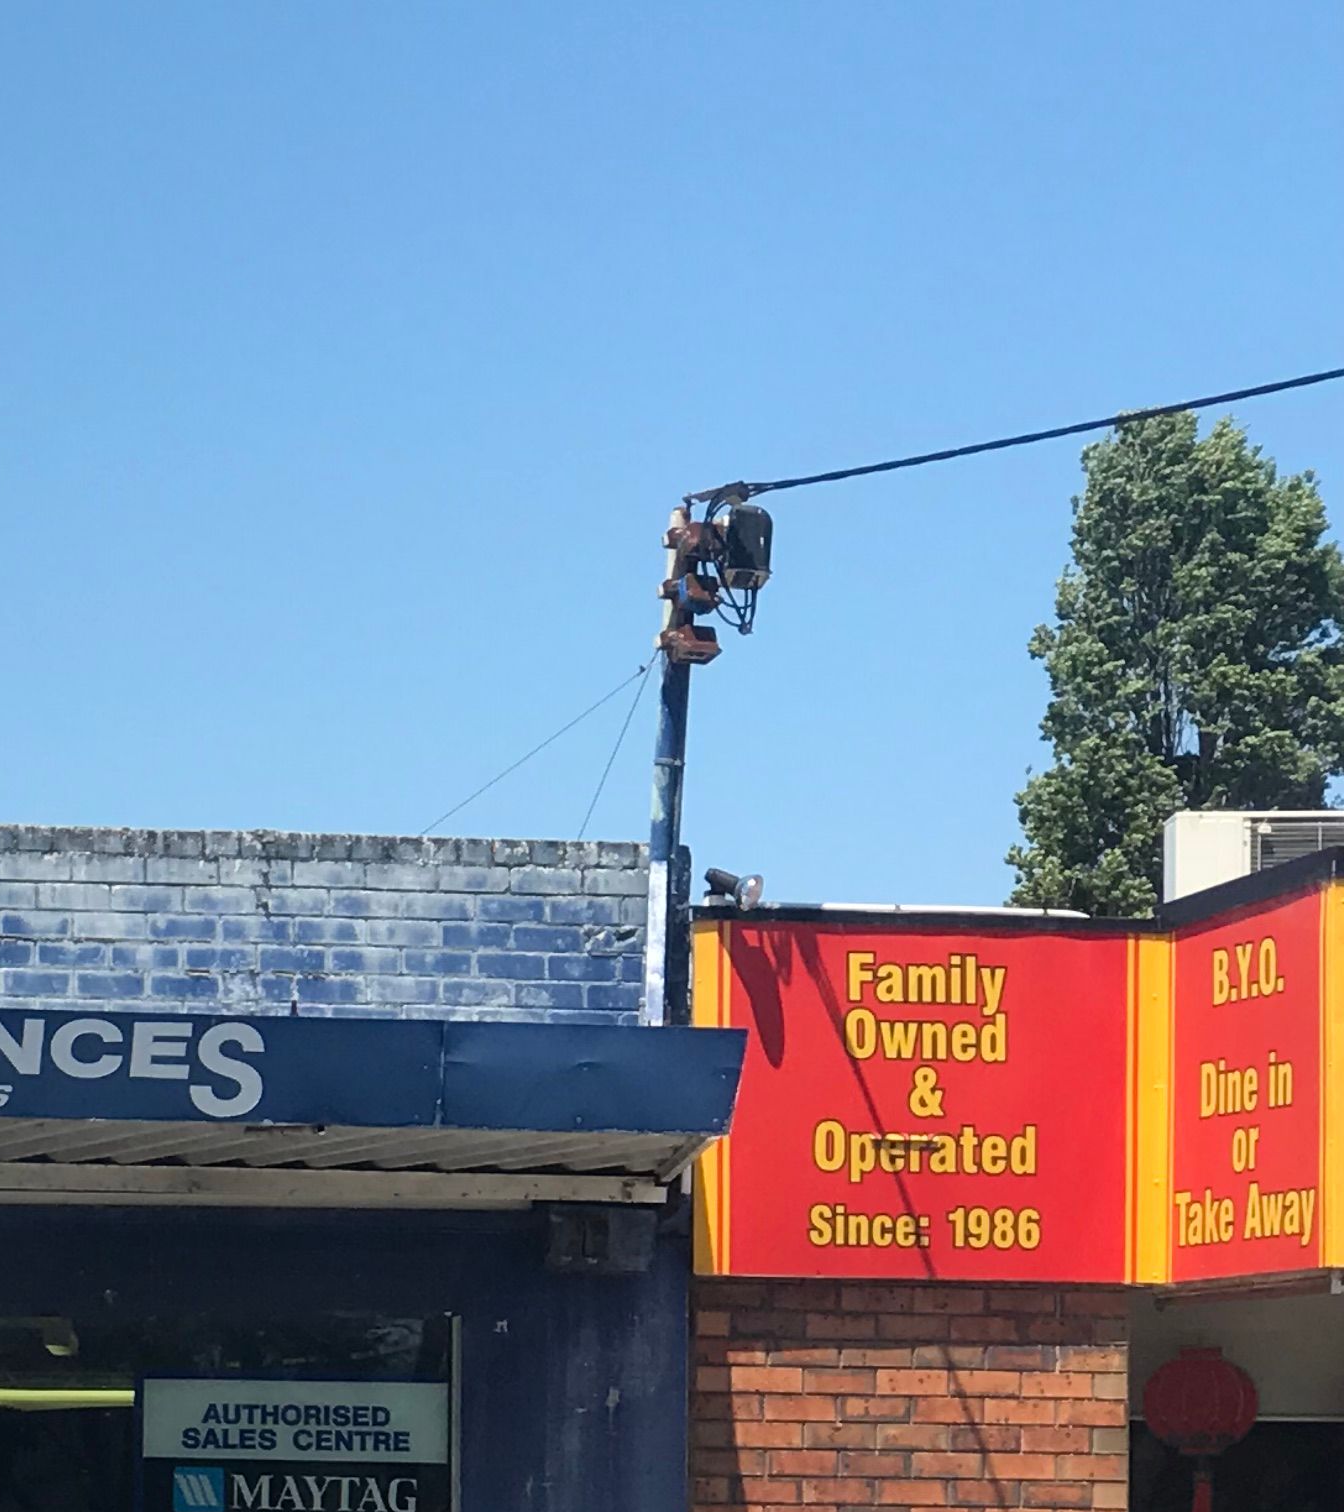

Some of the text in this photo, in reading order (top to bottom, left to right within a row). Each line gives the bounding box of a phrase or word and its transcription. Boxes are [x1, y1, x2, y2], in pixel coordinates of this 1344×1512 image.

[846, 951, 1006, 1015] Family
[1212, 936, 1285, 1007] B.Y.O.
[844, 1008, 1006, 1063] Owned
[909, 1066, 944, 1117] &
[1199, 1050, 1293, 1119] Dine in
[813, 1119, 1037, 1183] Operated
[1232, 1127, 1258, 1174] or
[808, 1203, 1042, 1250] Since: 1986
[1175, 1182, 1316, 1247] Take Away
[182, 1428, 411, 1452] SALES CENTRE
[201, 1404, 391, 1427] AUTHORISED
